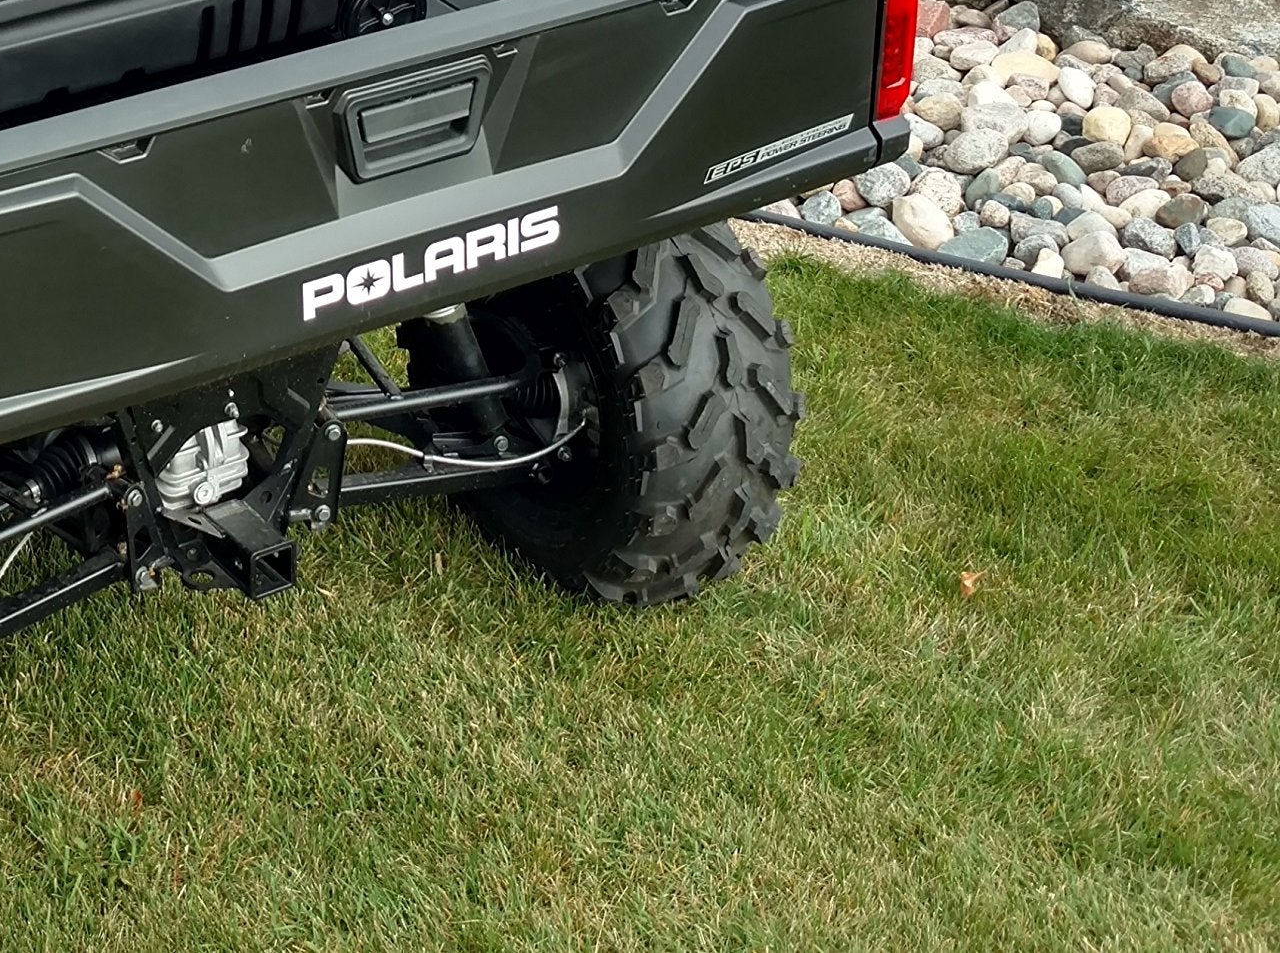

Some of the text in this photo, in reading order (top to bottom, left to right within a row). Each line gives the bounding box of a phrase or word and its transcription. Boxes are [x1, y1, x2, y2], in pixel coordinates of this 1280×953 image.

[709, 151, 758, 179] EPS
[760, 140, 798, 159] POWER
[799, 123, 847, 145] STEERING
[302, 205, 561, 322] POLARIS
